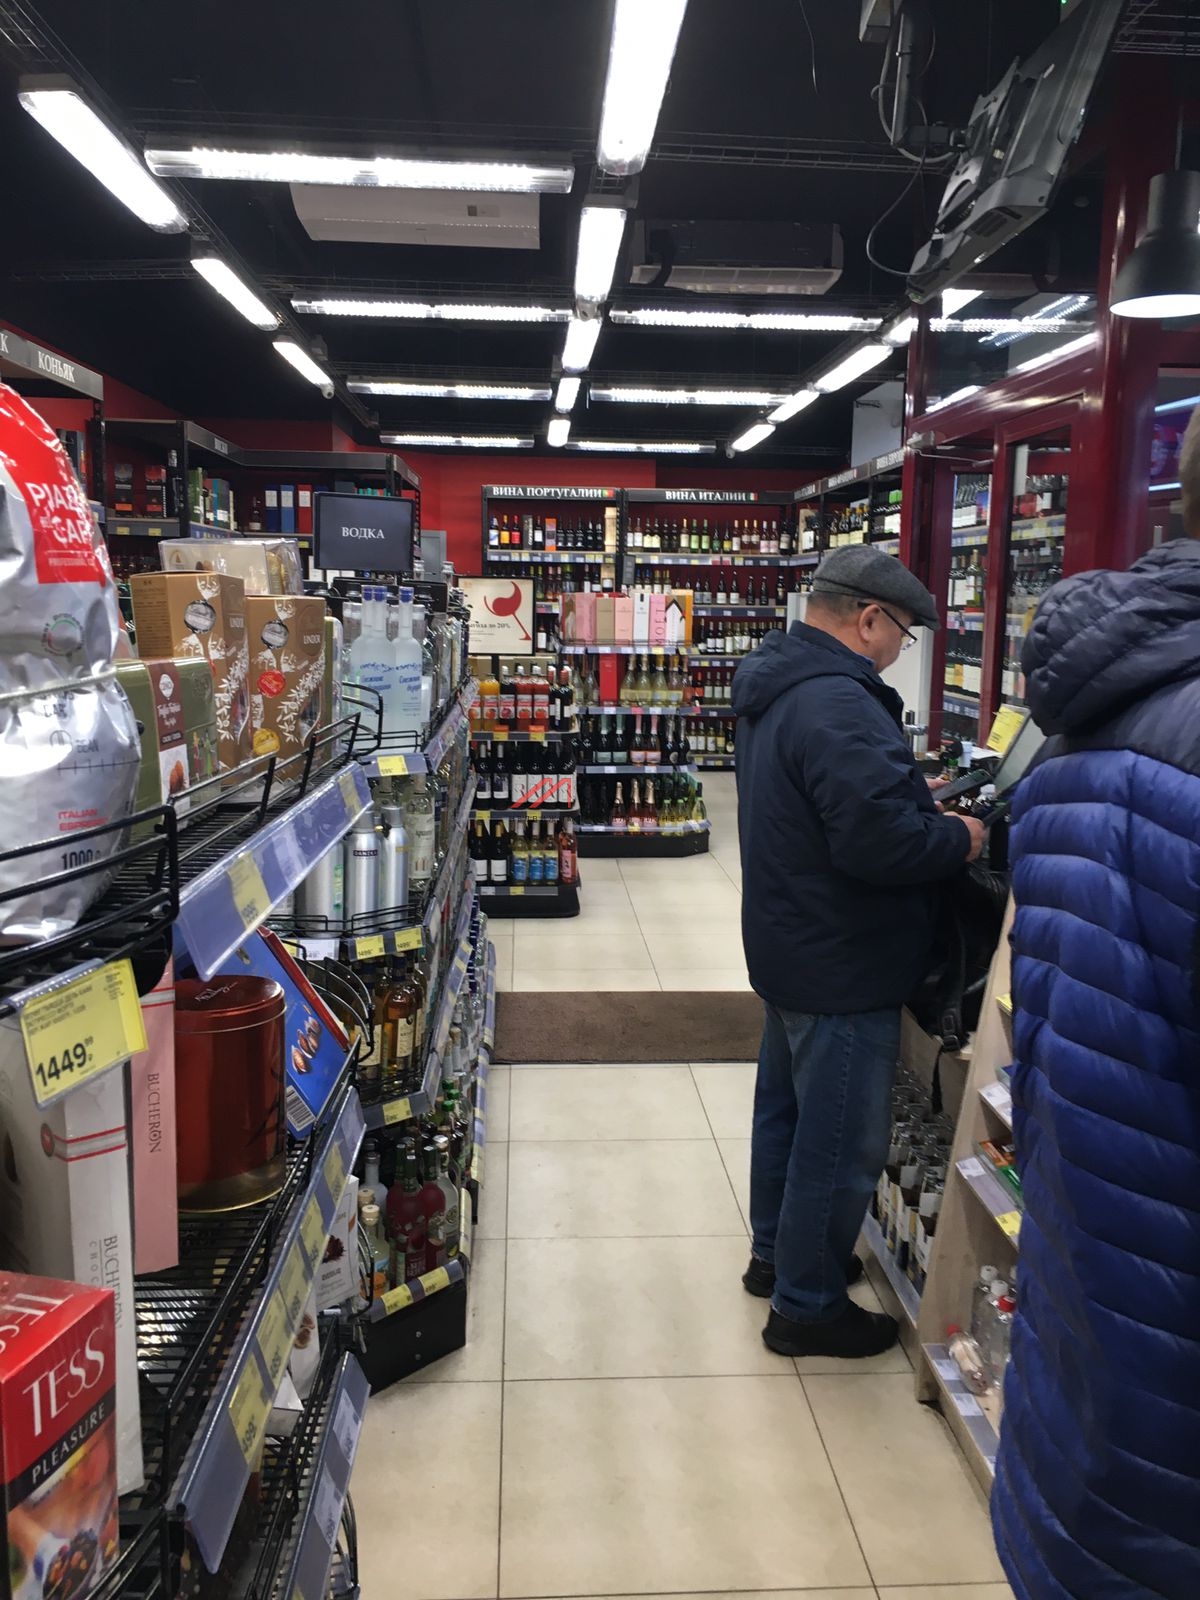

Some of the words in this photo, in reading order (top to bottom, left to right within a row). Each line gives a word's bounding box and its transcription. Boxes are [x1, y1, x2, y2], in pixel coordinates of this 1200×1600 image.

[37, 350, 75, 383] КОНЬЯК
[492, 486, 524, 496] ВИНА
[526, 487, 602, 499] ПОРТУГАЛИИ
[665, 490, 697, 501] ВИНА
[699, 491, 747, 502] ИТАЛИИ
[341, 526, 385, 540] ВОДКА
[35, 1042, 87, 1088] 1449
[147, 1072, 162, 1154] BUCHERON
[22, 1324, 105, 1437] TESS
[32, 1401, 105, 1485] PLEASURE
